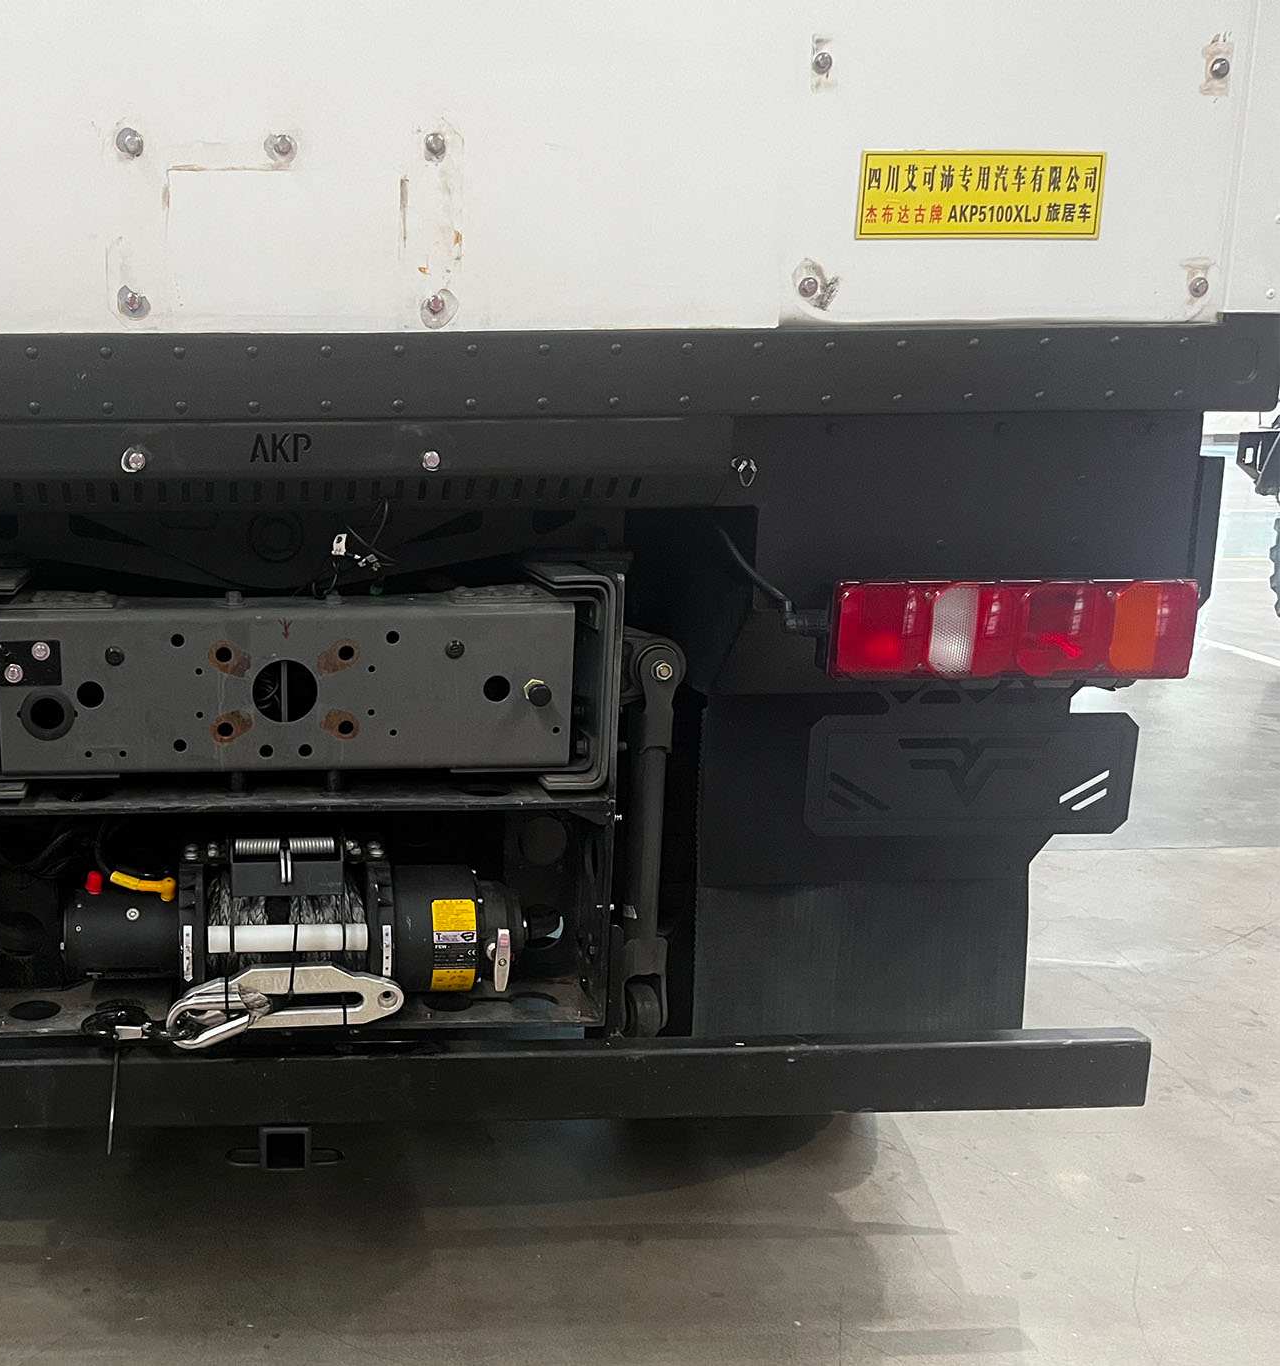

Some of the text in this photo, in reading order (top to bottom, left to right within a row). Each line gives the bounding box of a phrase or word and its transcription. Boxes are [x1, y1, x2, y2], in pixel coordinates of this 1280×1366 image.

[867, 165, 1098, 193] 四川艾可沛专用汽车有限公司
[865, 202, 1092, 224] 杰布达古牌 AKP5100XLJ 旅居车
[249, 433, 312, 462] AKP
